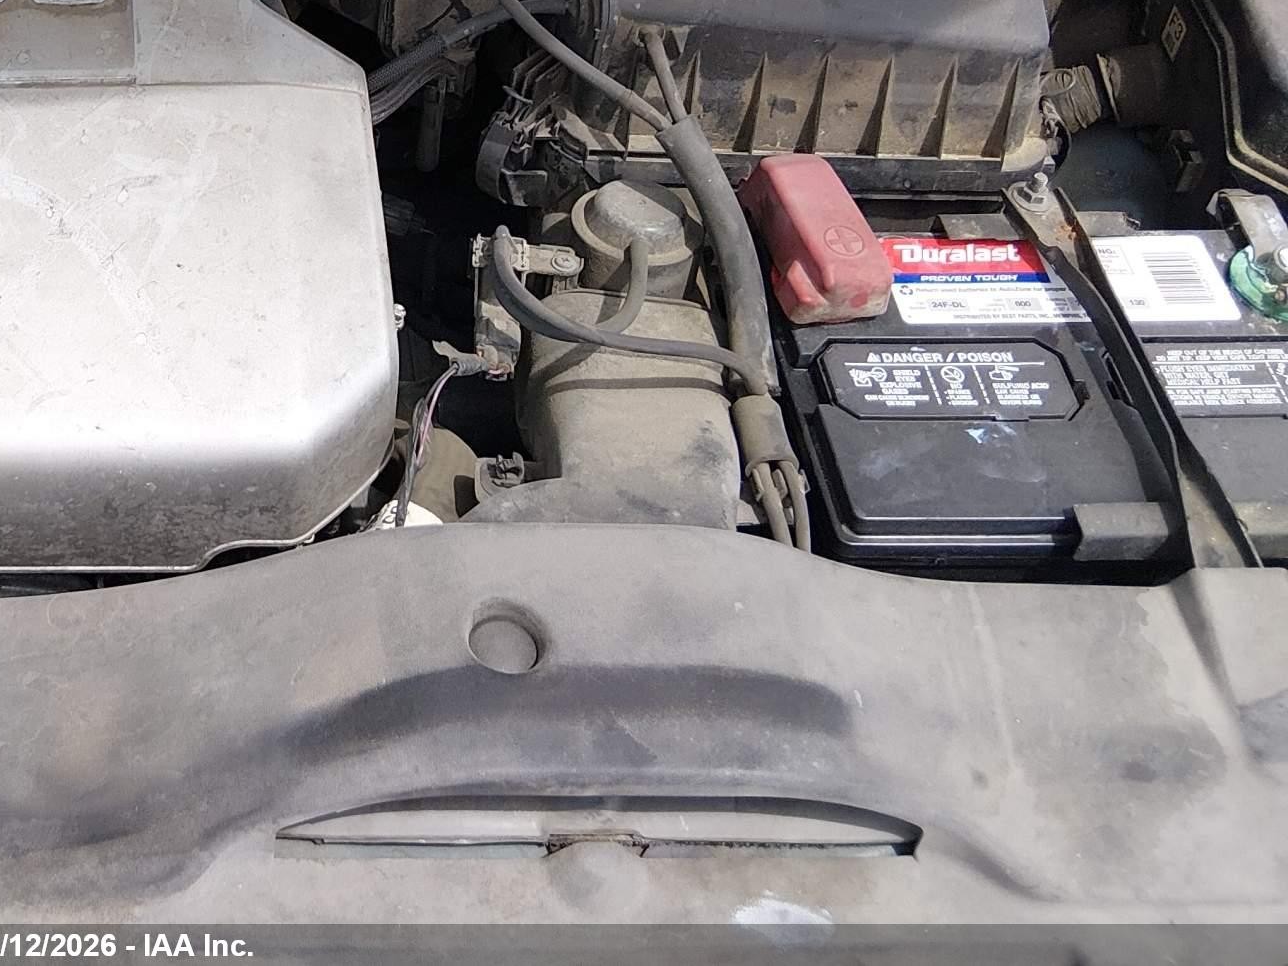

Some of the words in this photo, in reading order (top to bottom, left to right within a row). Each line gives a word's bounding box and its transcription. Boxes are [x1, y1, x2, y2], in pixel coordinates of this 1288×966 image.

[893, 242, 1021, 264] Duralast
[975, 274, 1018, 282] TOUGH
[882, 353, 943, 362] DANGER
[946, 352, 954, 362] /
[957, 352, 1013, 362] POISON
